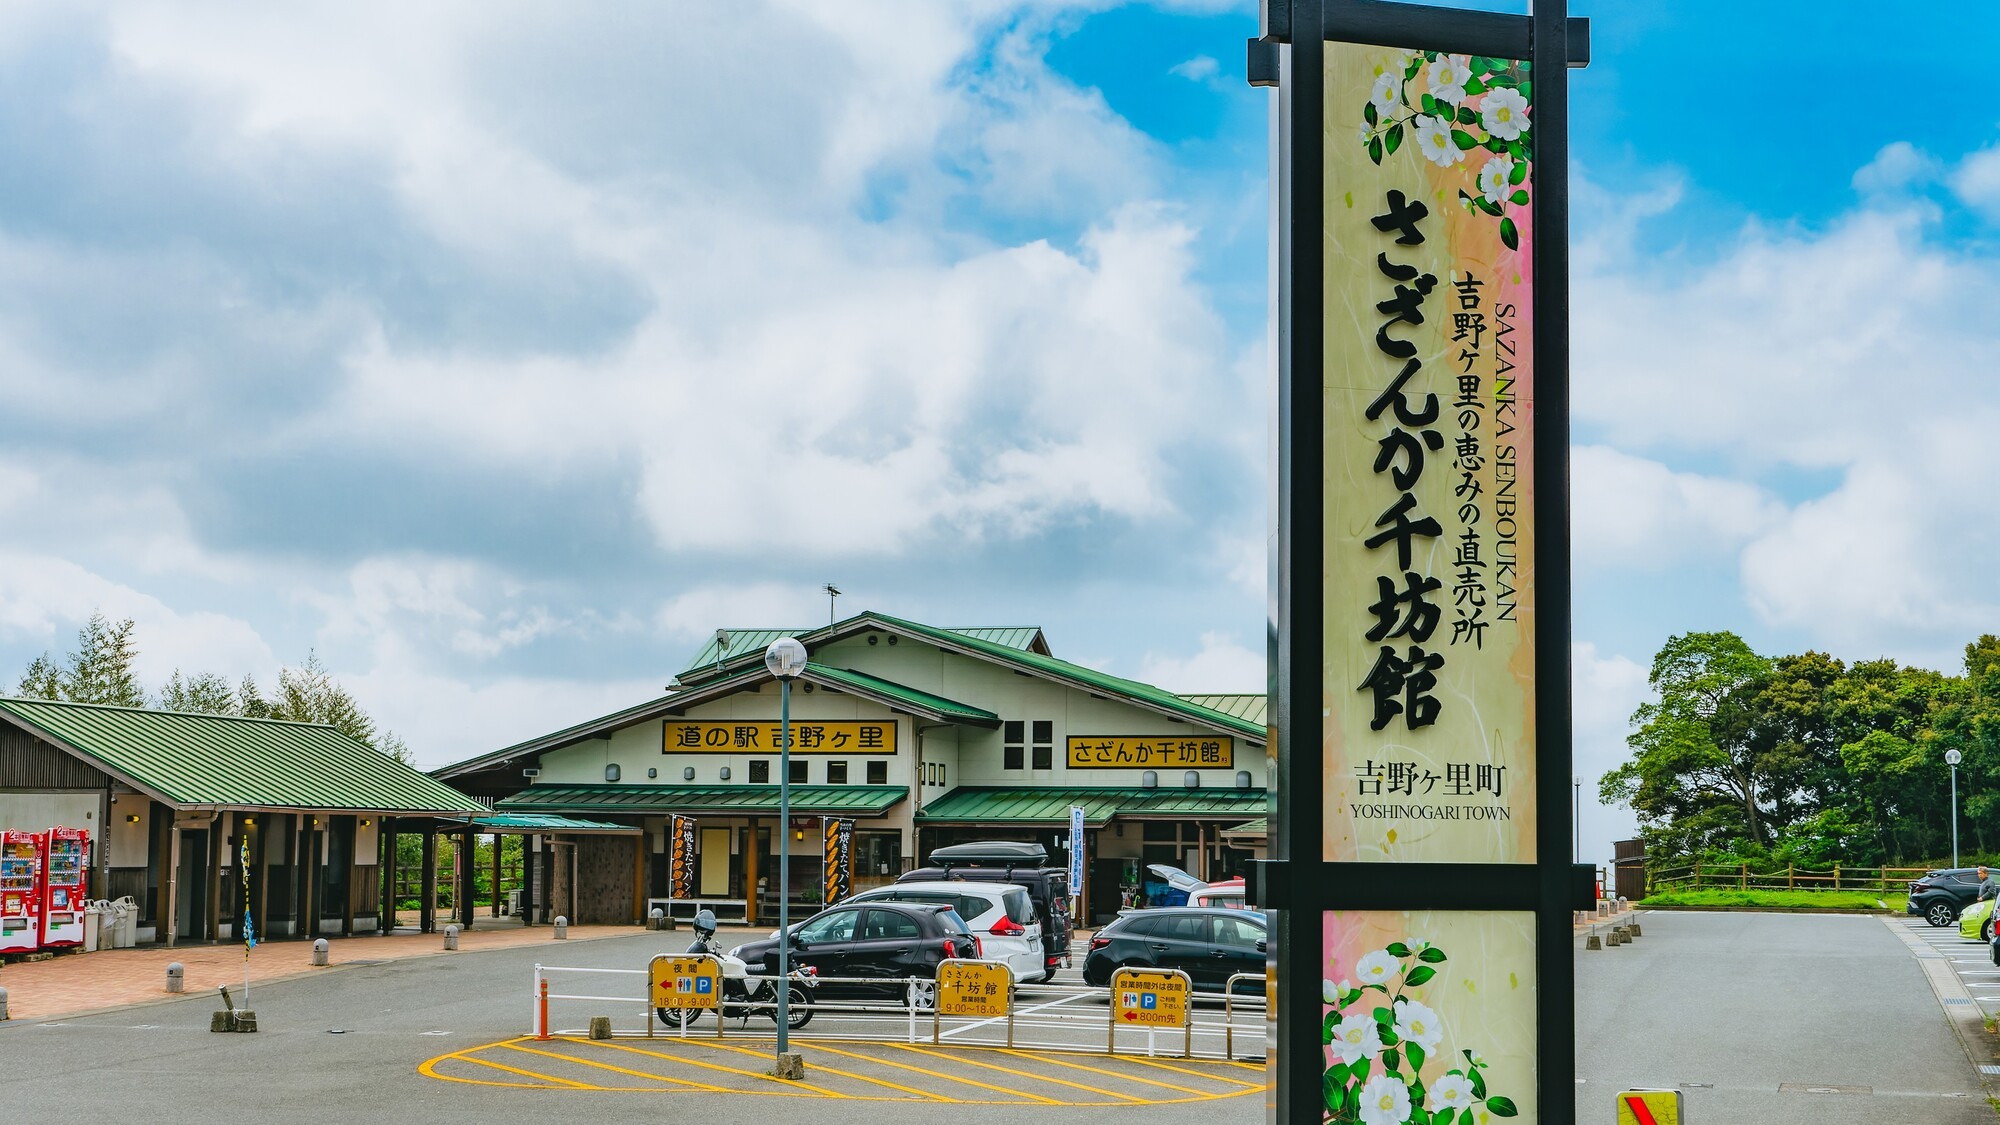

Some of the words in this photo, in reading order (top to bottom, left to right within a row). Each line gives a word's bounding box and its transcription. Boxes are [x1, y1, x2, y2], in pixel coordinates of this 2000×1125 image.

[1495, 303, 1517, 440] SAZANKA
[1357, 189, 1445, 731] さざんか千坊館
[1495, 445, 1518, 624] SENBOUKAN
[676, 726, 759, 748] 道の駅
[1074, 741, 1220, 763] さざんか千坊館
[1350, 804, 1460, 820] YOSHINOGARI
[1463, 806, 1511, 820] TOWN
[946, 969, 982, 980] さざんか
[951, 980, 998, 996] 千坊館
[1120, 980, 1182, 992] 営業時間外は夜間
[961, 995, 987, 1004] 営業時間
[1139, 1012, 1176, 1024] 800m先
